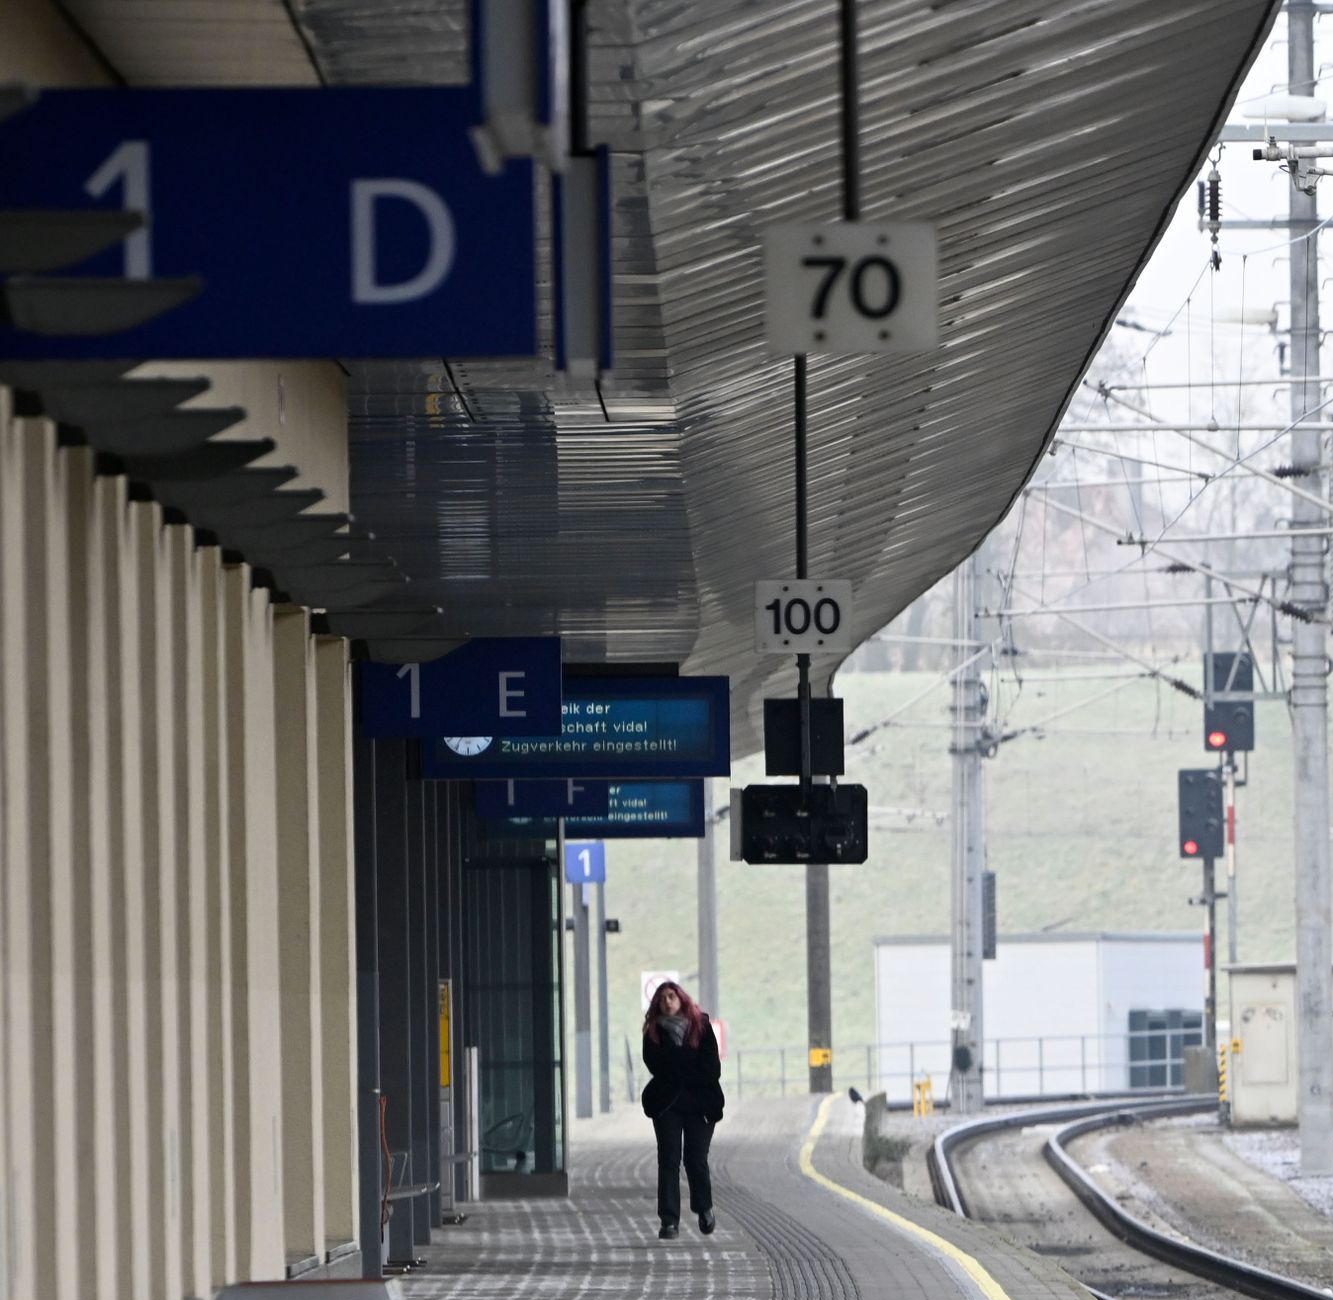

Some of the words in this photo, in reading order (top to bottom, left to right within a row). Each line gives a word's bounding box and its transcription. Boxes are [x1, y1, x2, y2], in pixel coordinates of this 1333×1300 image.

[84, 141, 152, 280] 1
[351, 178, 455, 304] D
[802, 255, 902, 320] 70
[766, 598, 840, 634] 100
[396, 663, 421, 718] 1
[498, 671, 527, 717] E
[586, 703, 611, 715] der
[501, 740, 587, 753] Zugverkehr
[578, 849, 591, 877] 1
